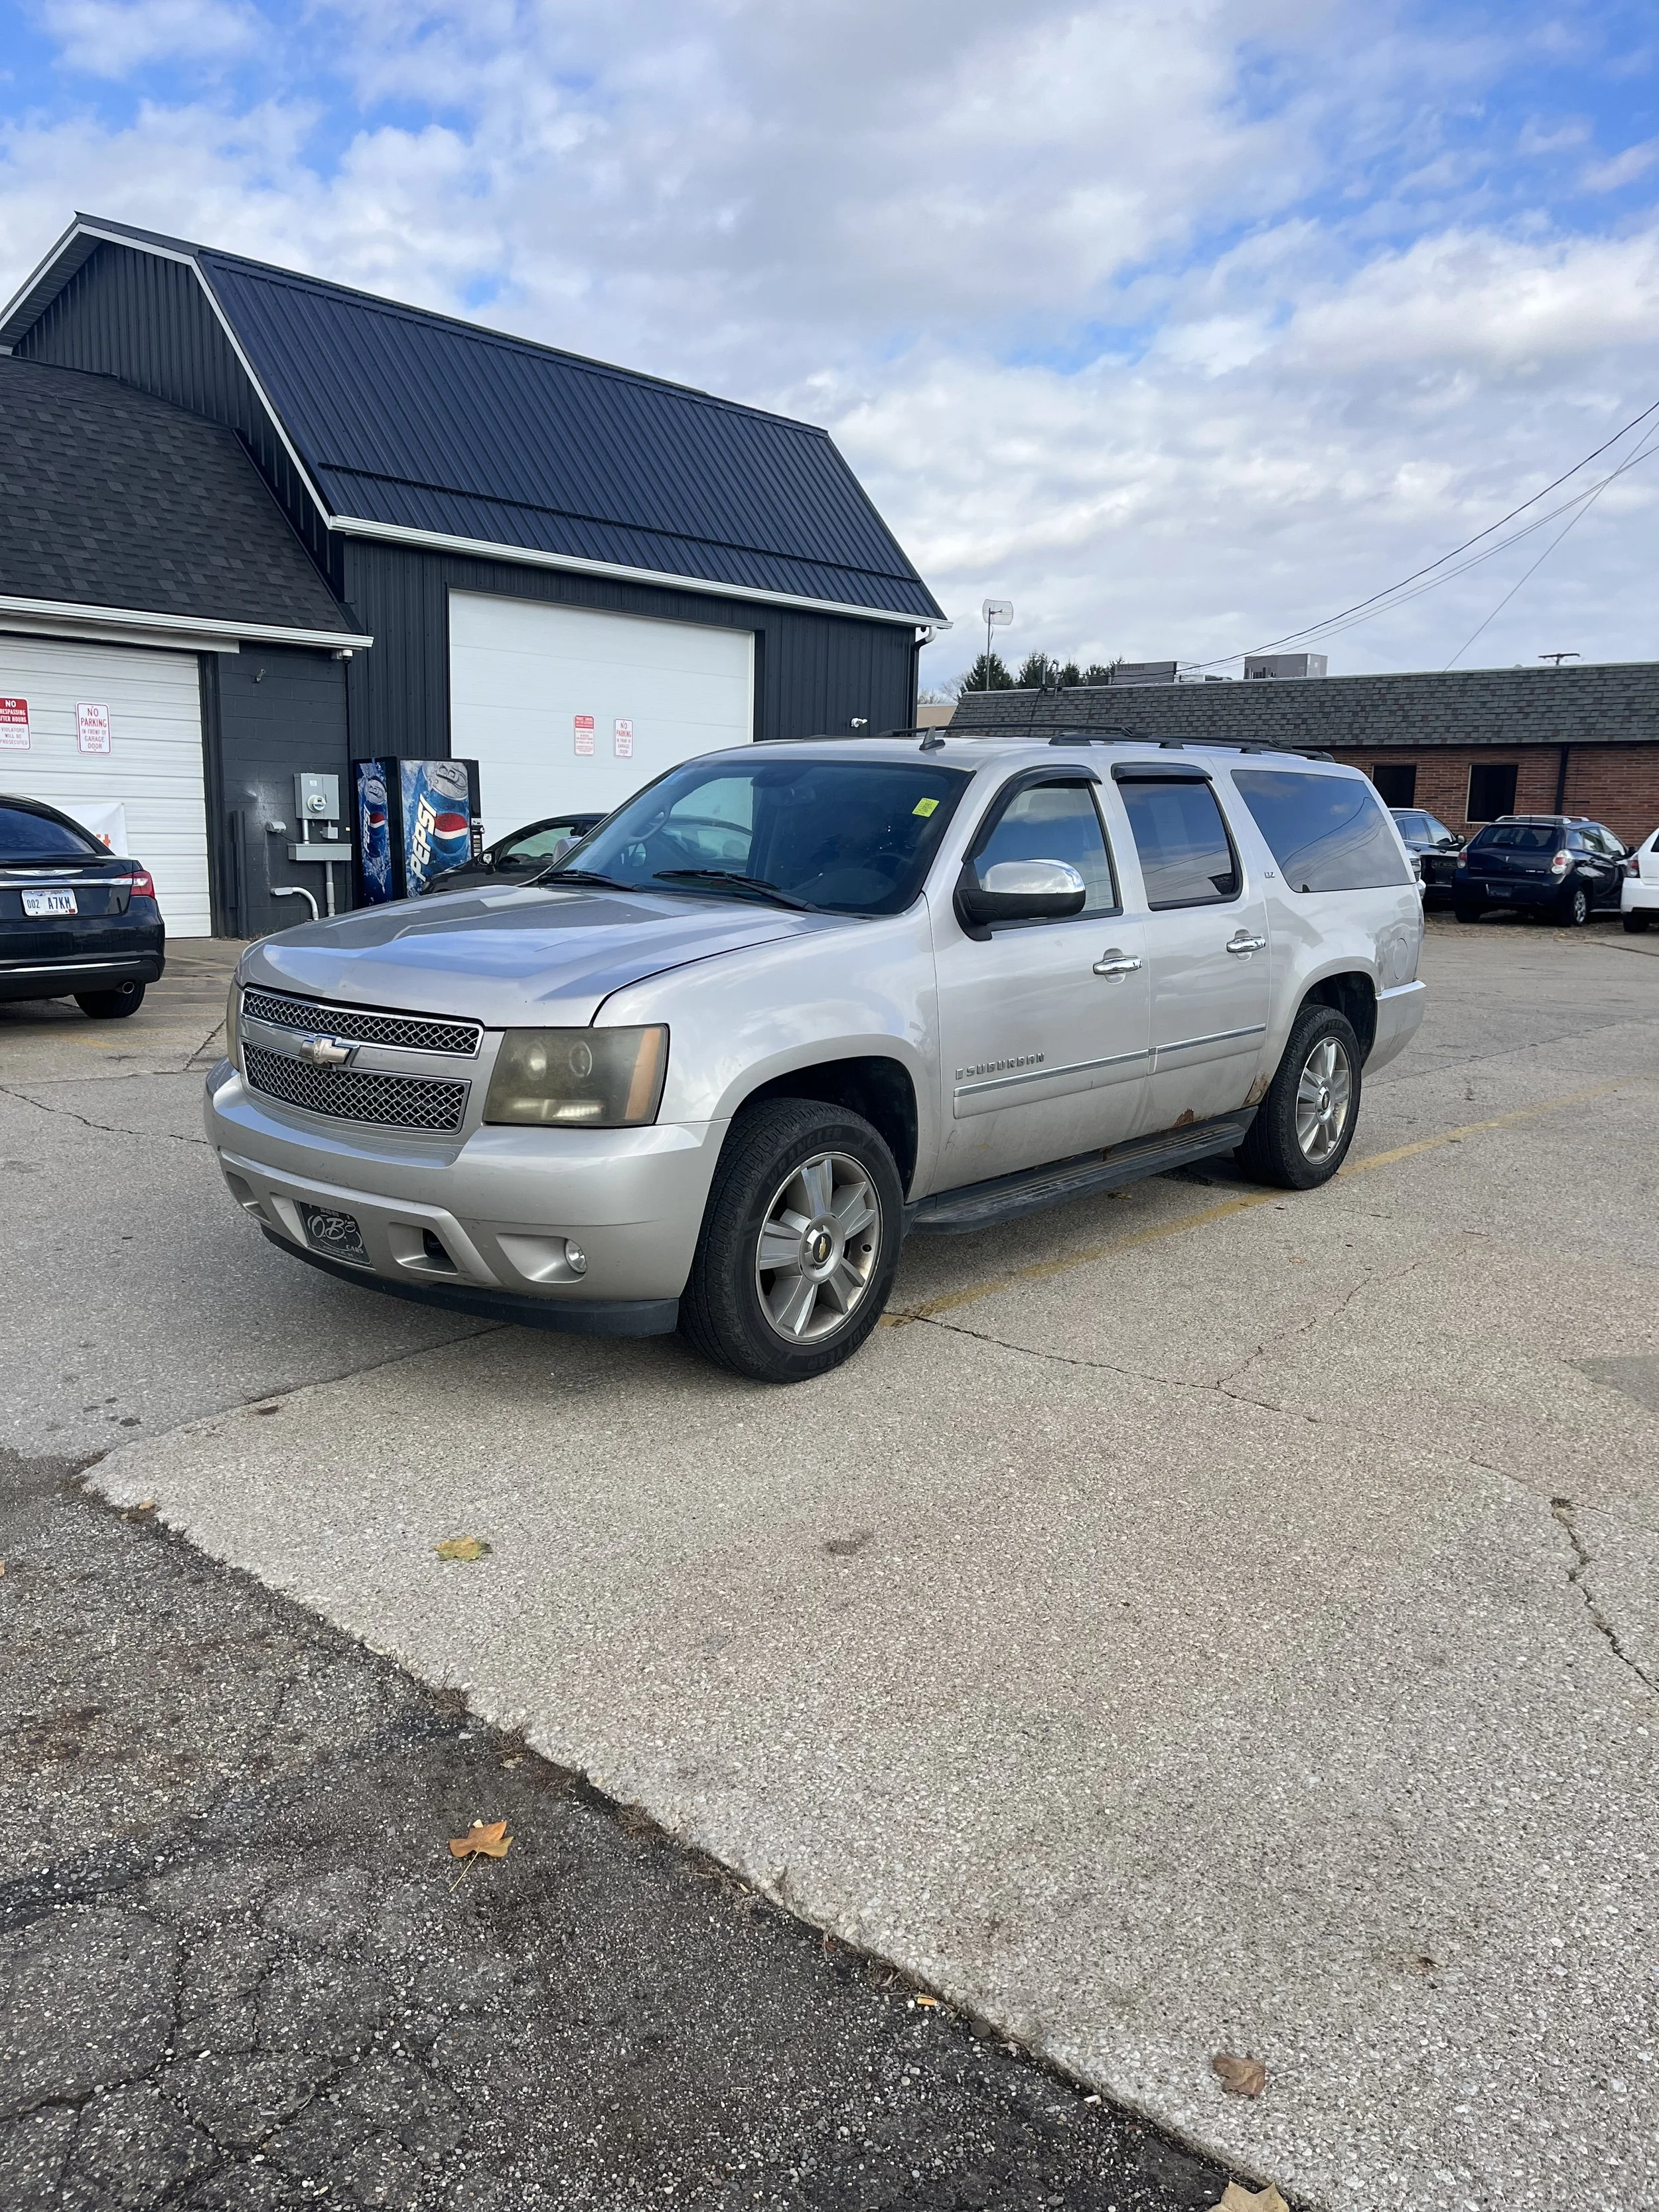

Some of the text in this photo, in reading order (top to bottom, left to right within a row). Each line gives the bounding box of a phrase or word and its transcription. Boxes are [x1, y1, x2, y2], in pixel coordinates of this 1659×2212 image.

[87, 707, 99, 717] NO
[80, 717, 107, 728] PARKING
[410, 792, 437, 882] PEPSI
[27, 899, 40, 909] 002
[966, 1052, 1045, 1077] SUBURBAN
[807, 1300, 882, 1370] GOODYEAR
